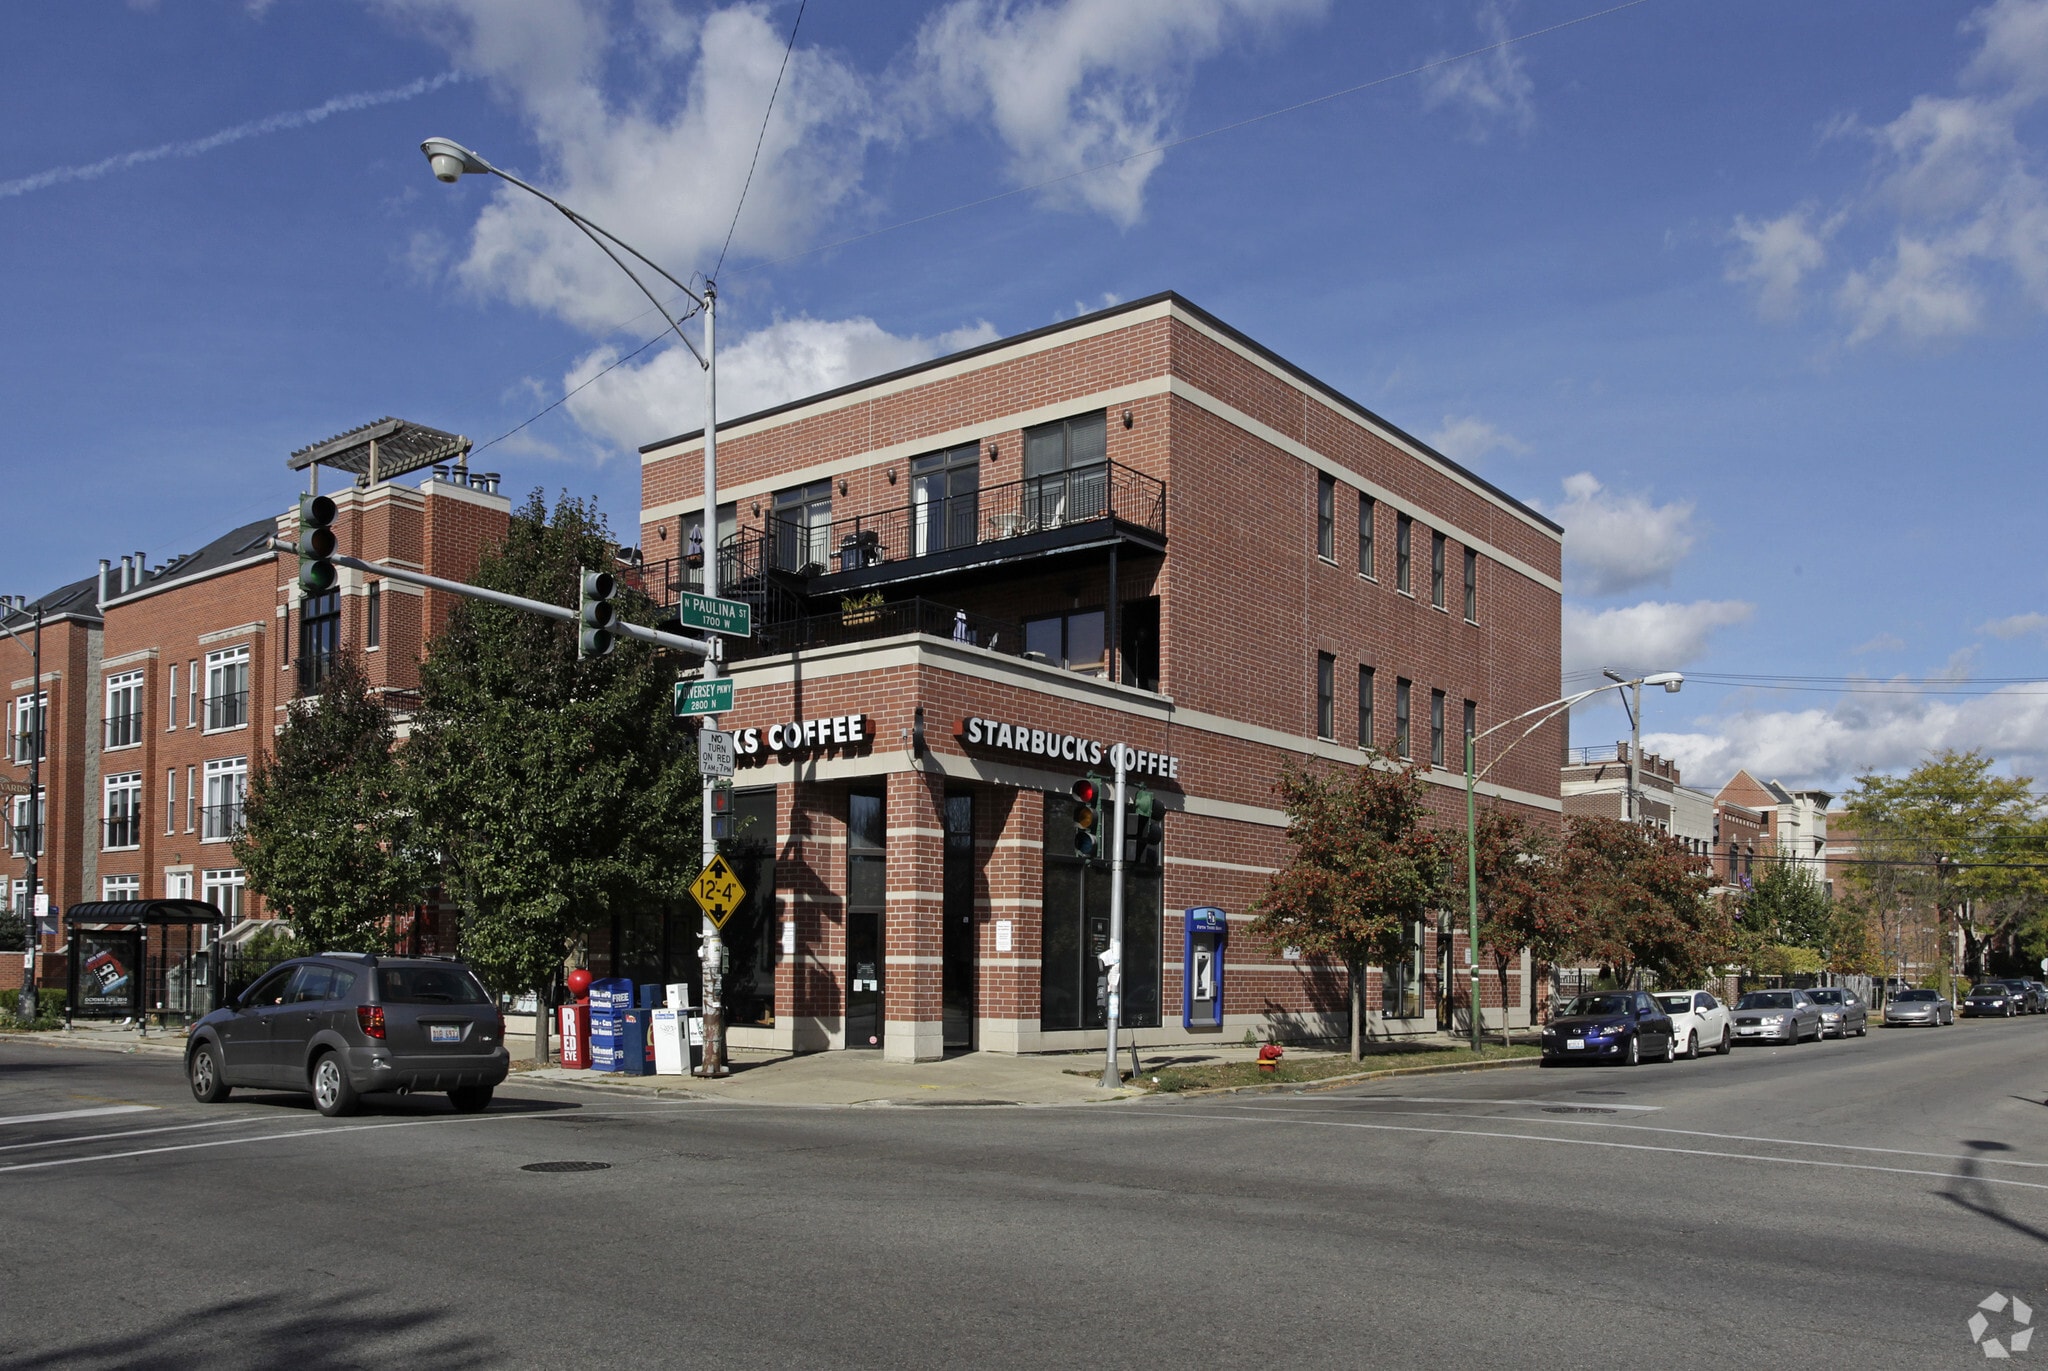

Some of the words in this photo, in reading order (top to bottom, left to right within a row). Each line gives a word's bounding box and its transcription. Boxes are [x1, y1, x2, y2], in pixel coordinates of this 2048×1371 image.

[684, 598, 690, 608] N
[693, 598, 736, 619] PAULINA
[739, 609, 746, 618] ST
[703, 615, 721, 627] 1700
[724, 619, 731, 629] W
[717, 685, 732, 695] PKWY
[690, 701, 708, 710] 2800
[711, 700, 717, 709] N
[768, 714, 863, 751] COFFEE
[711, 734, 723, 744] NO
[967, 717, 1102, 765] STARBUCKS
[708, 743, 727, 754] TURN
[702, 752, 713, 762] ON
[716, 754, 731, 764] RED
[612, 992, 629, 1002] FREE
[562, 1007, 576, 1036] R
[563, 1035, 577, 1051] ED
[564, 1050, 578, 1062] EYE
